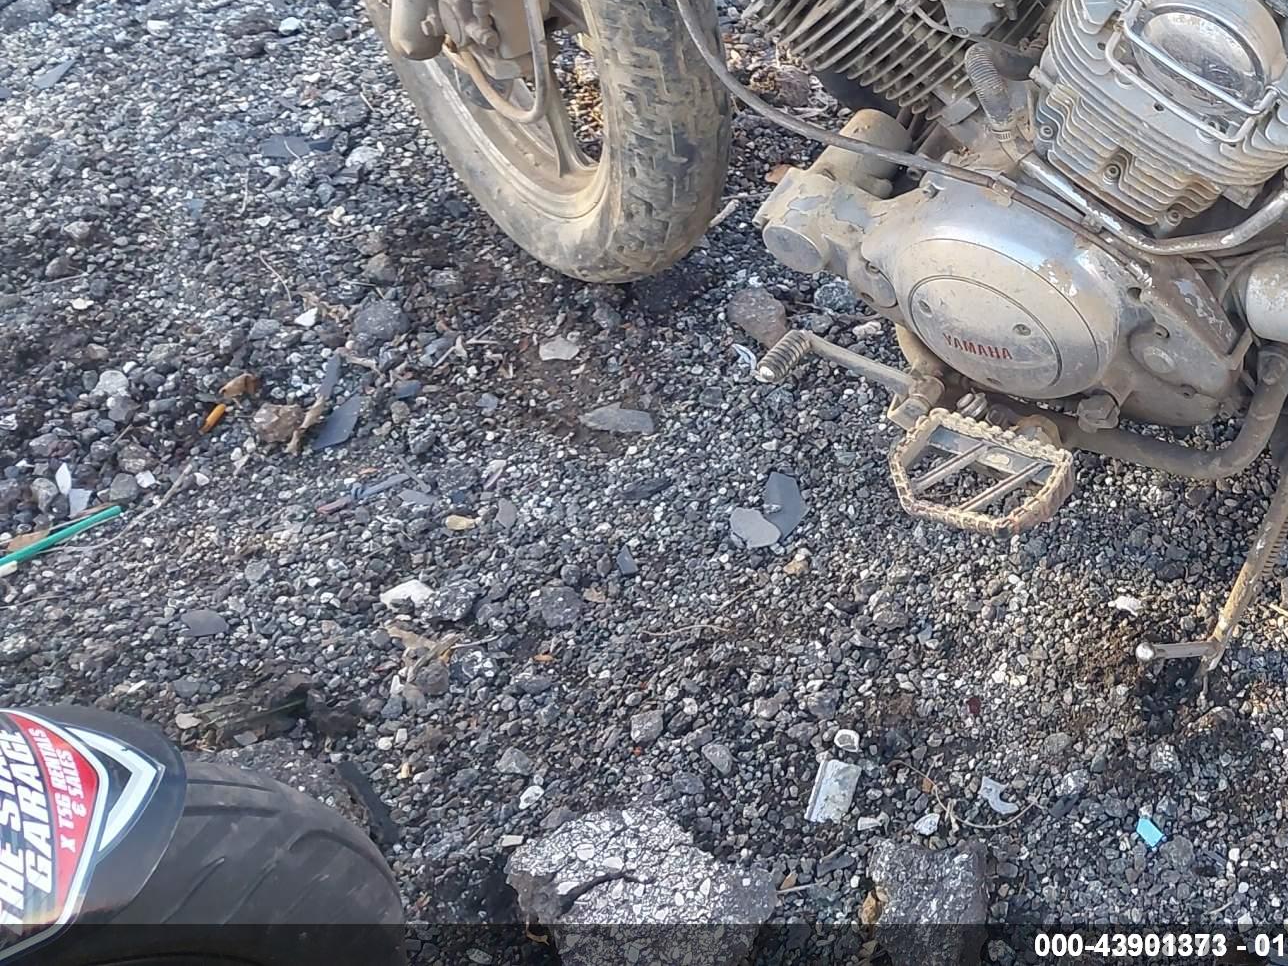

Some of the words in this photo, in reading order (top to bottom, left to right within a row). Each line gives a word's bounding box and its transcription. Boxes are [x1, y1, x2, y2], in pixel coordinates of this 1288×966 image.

[942, 332, 1014, 361] YAMAHA
[27, 727, 68, 792] RENTALS
[55, 748, 85, 800] SALES
[0, 728, 53, 895] GARAGE
